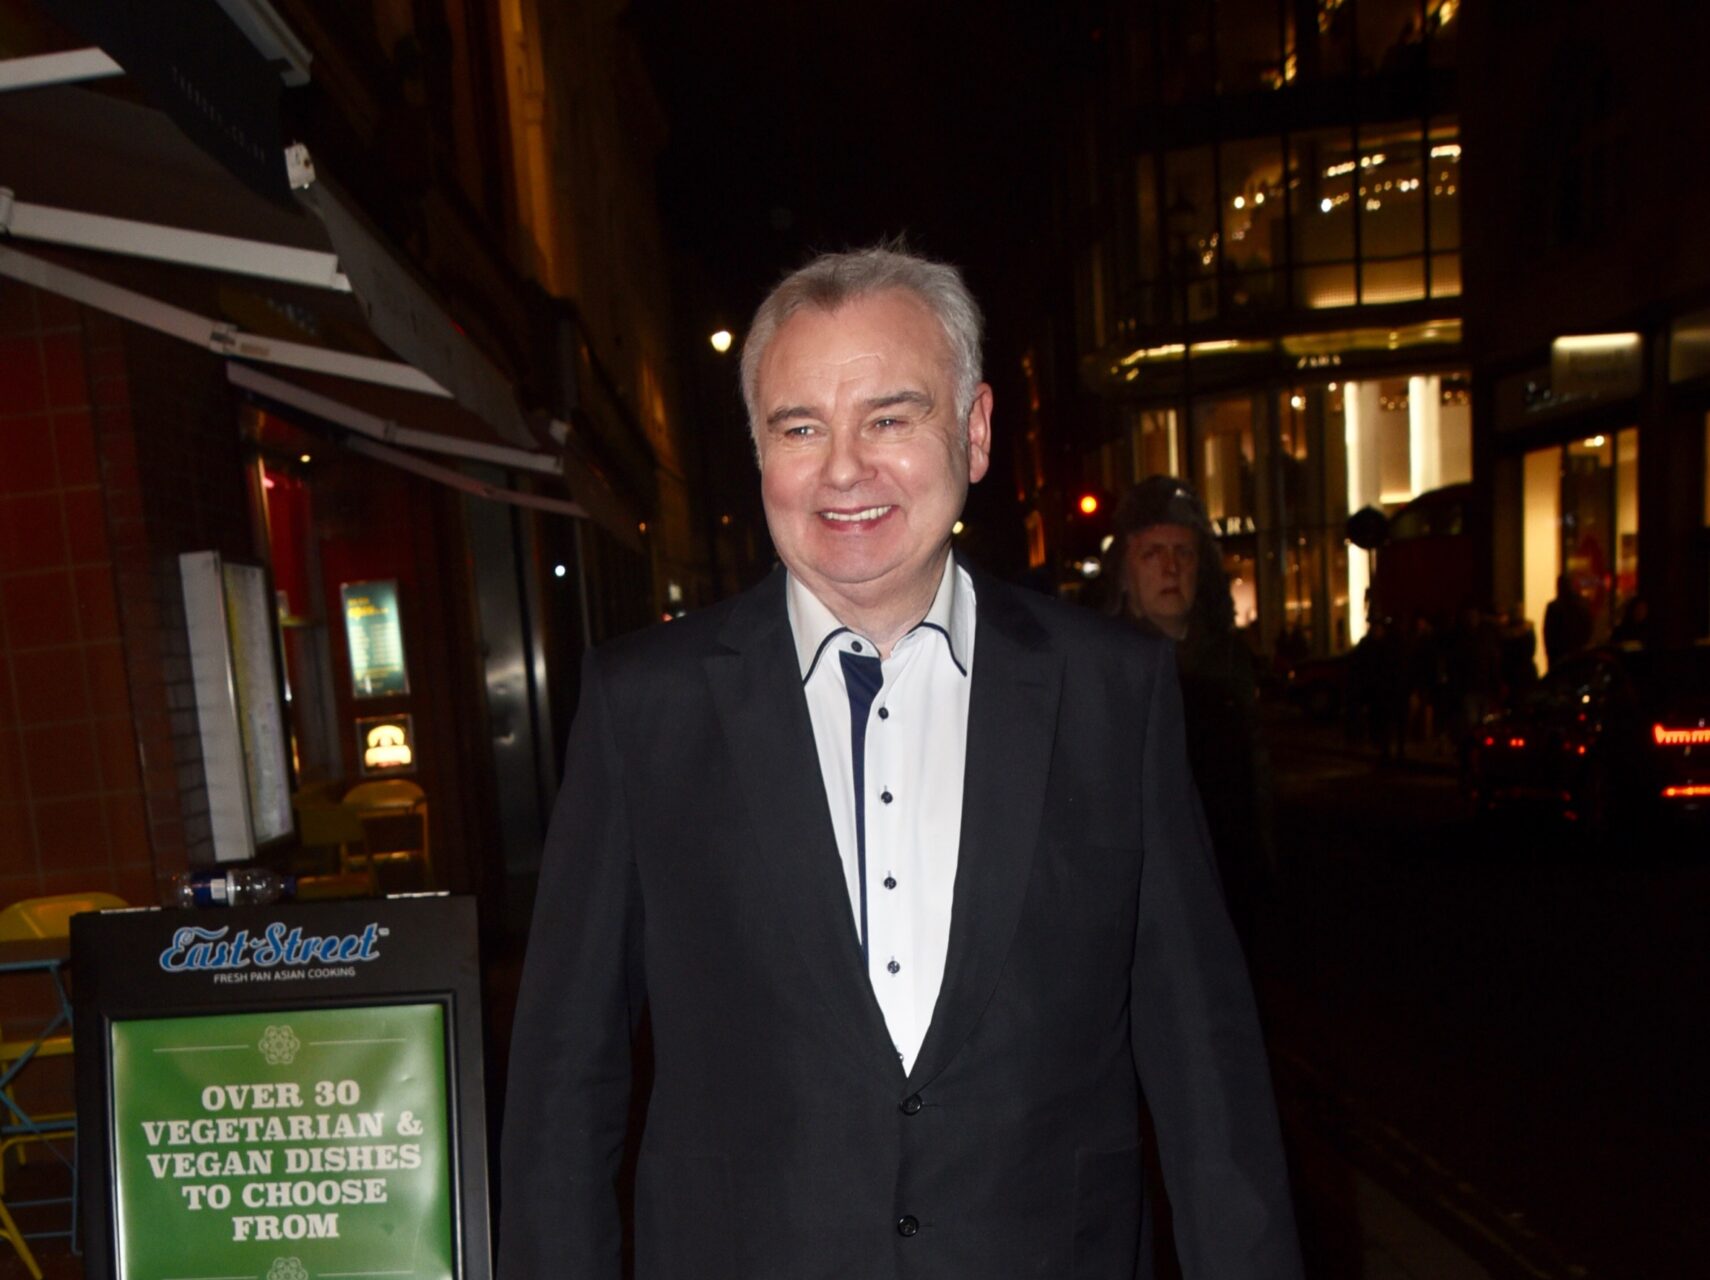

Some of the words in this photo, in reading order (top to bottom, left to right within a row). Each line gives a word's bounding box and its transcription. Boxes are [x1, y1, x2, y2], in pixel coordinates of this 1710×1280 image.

[160, 925, 251, 972] East
[213, 972, 248, 984] FRESH
[250, 971, 272, 982] PAN
[274, 970, 305, 981] ASIAN
[307, 966, 356, 979] COOKING
[201, 1083, 304, 1111] OVER
[315, 1080, 361, 1107] 30
[141, 1113, 385, 1146] VEGETARIAN
[396, 1110, 424, 1136] &
[147, 1150, 273, 1179] VEGAN
[284, 1144, 422, 1174] DISHES
[182, 1184, 232, 1210] TO
[242, 1178, 388, 1208] CHOOSE
[232, 1213, 340, 1242] FROM
